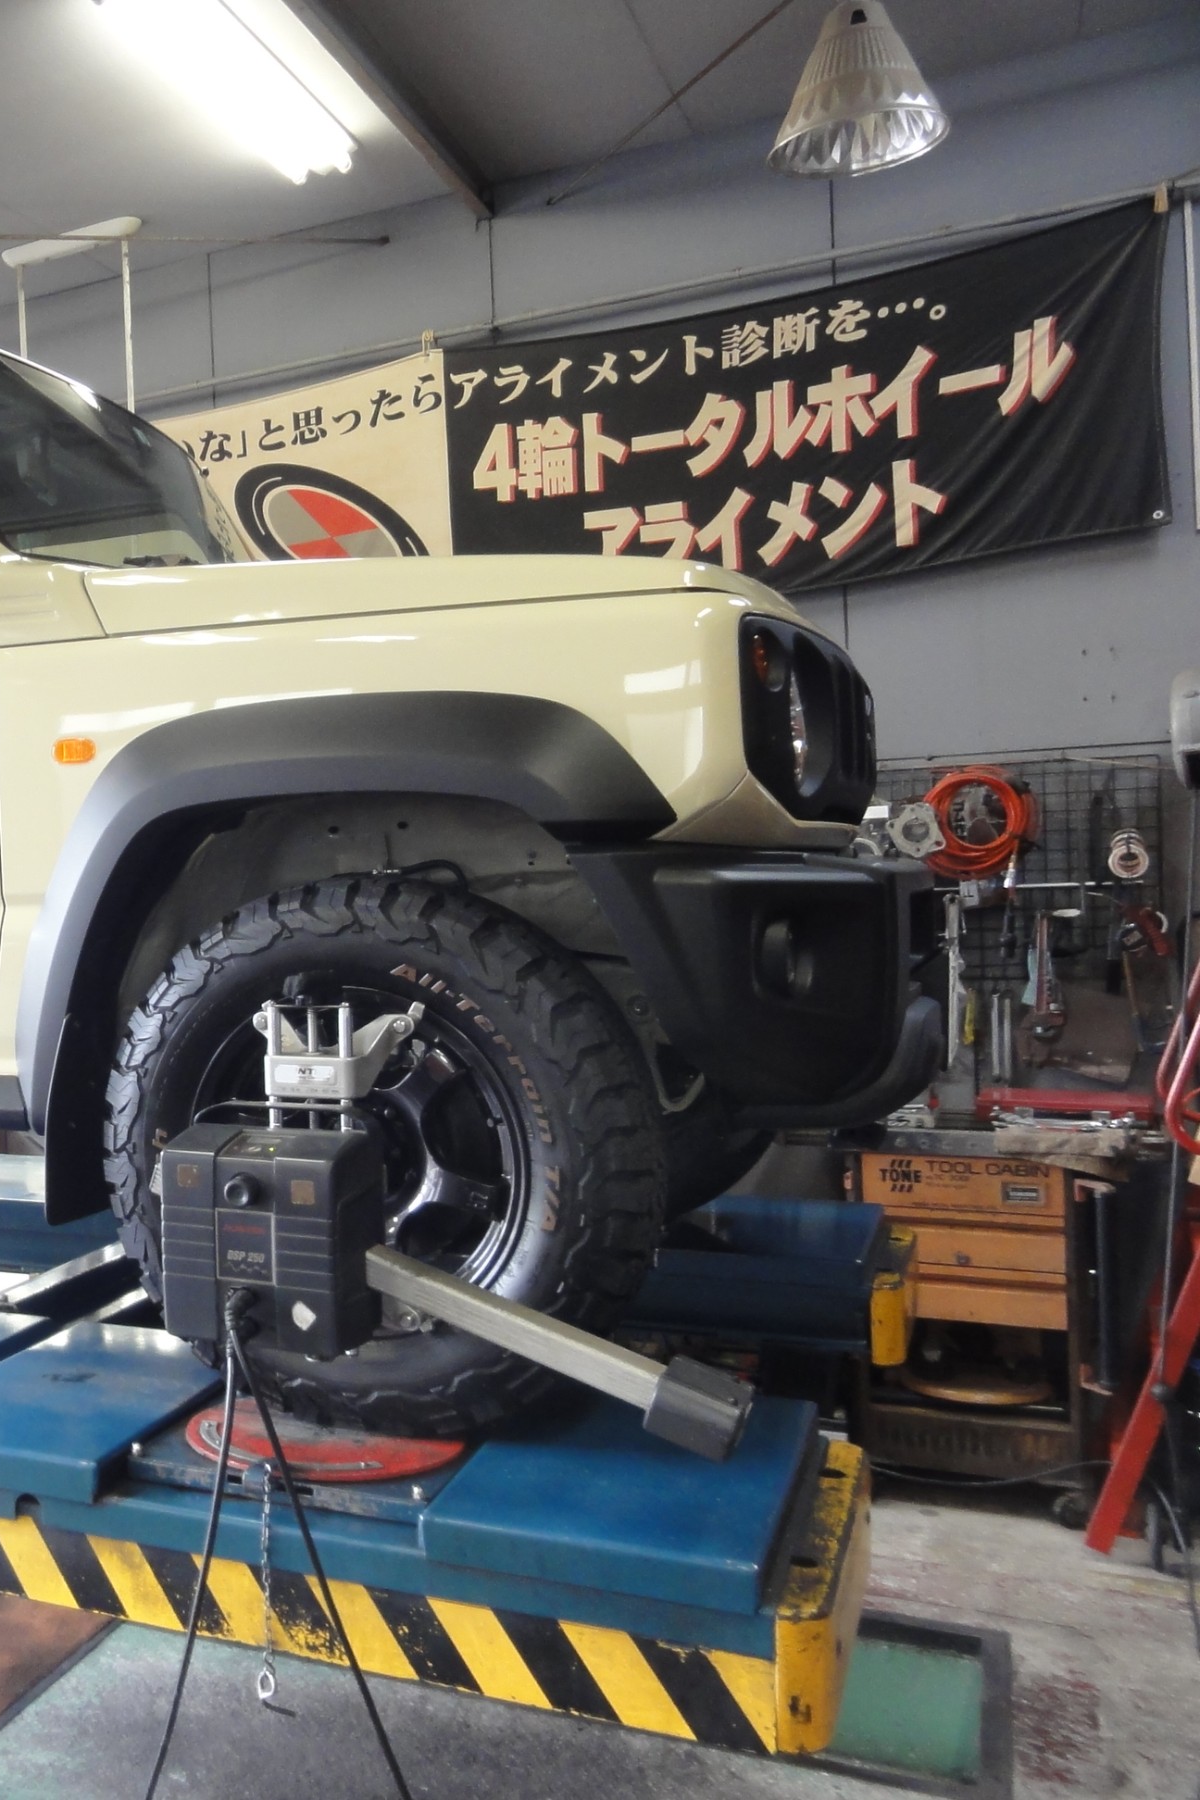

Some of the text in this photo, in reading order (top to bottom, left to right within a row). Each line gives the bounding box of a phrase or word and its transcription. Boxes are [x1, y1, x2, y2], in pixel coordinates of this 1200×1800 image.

[473, 316, 1074, 502] 4輪トータルホイール
[583, 459, 946, 570] アライメント
[879, 1168, 922, 1183] TONE
[925, 1159, 981, 1175] TOOL
[985, 1162, 1049, 1178] CABIN
